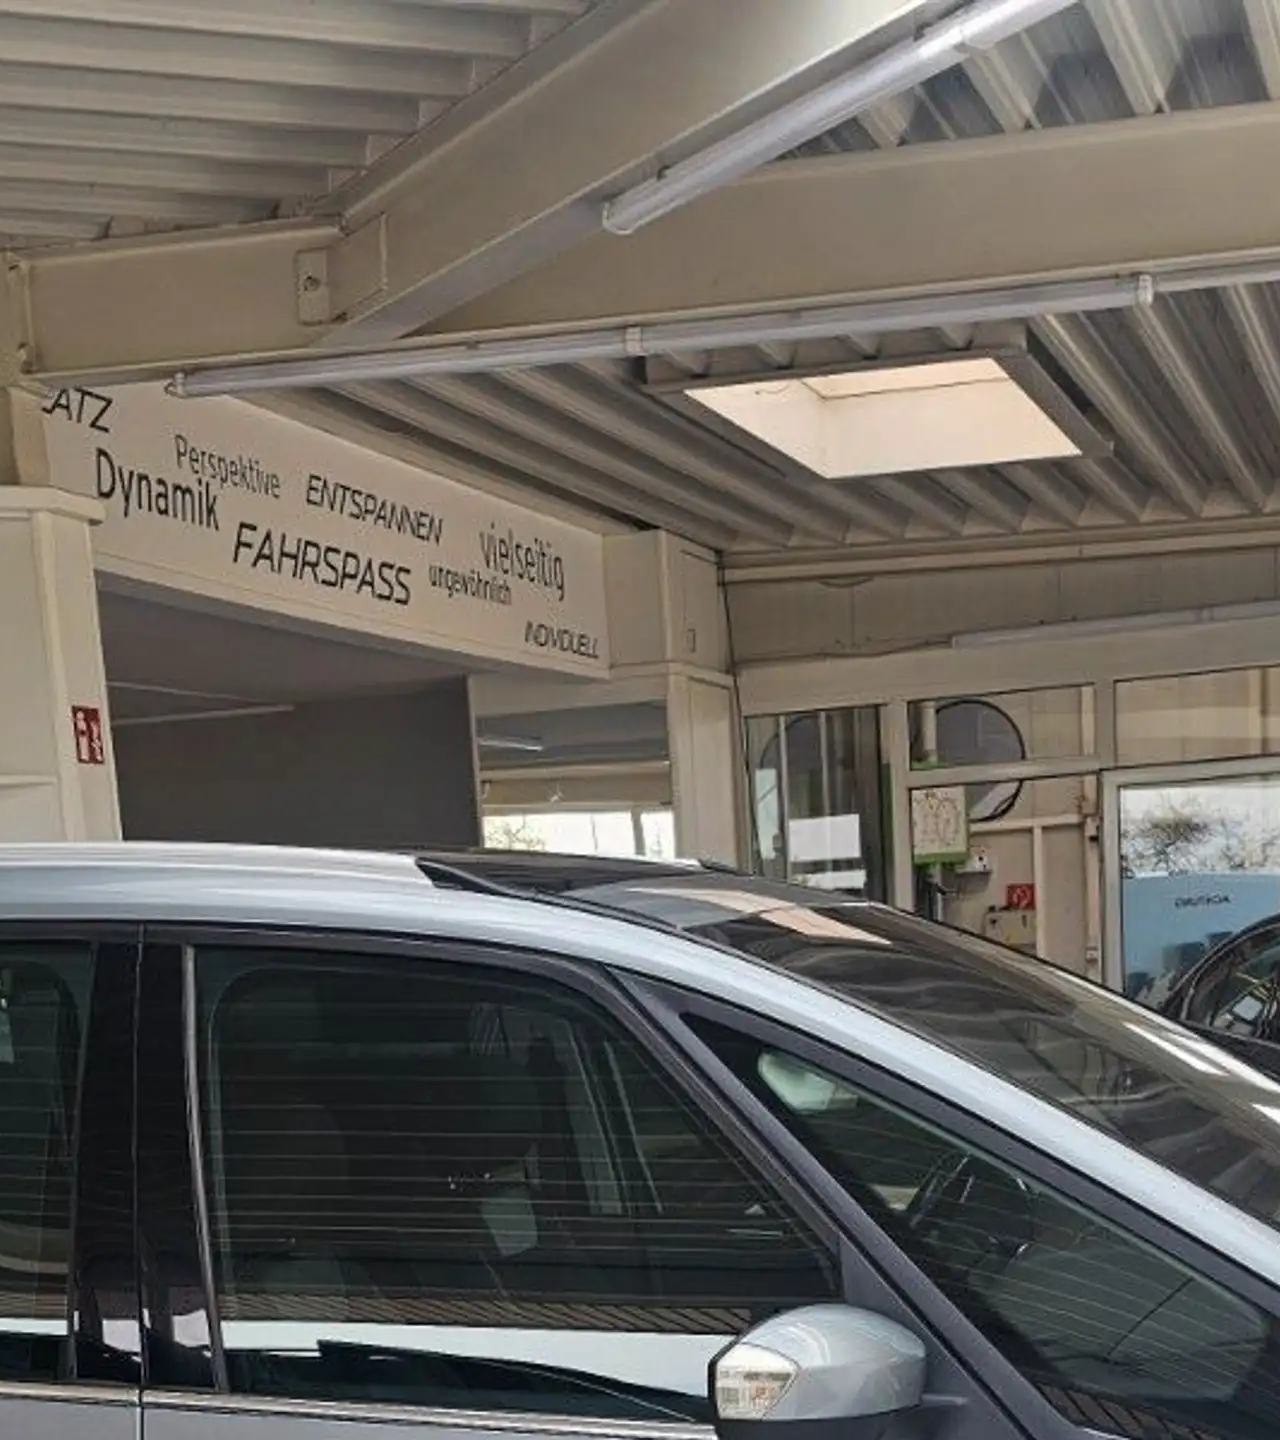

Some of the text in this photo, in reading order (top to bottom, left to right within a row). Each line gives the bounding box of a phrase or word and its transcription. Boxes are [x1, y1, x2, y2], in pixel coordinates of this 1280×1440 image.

[95, 447, 220, 532] Dynamik
[174, 434, 282, 499] Perspektive
[305, 474, 445, 547] ENTSPANNEN
[232, 522, 412, 606] FAHRSPASS
[478, 521, 565, 602] vielseitig
